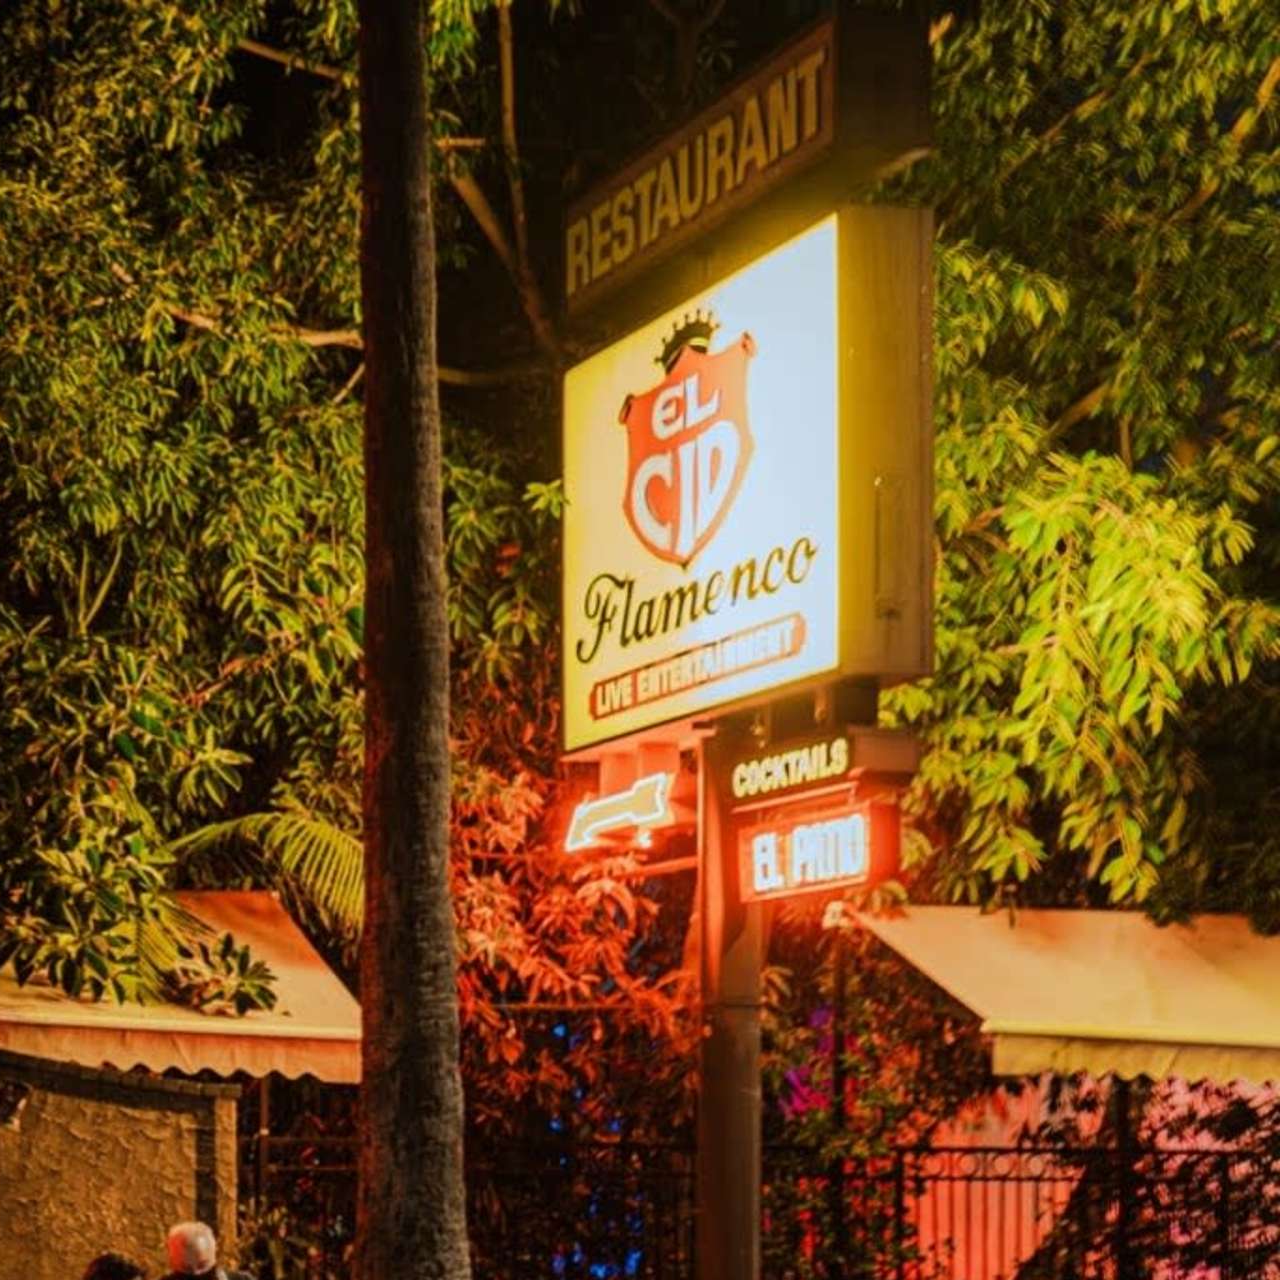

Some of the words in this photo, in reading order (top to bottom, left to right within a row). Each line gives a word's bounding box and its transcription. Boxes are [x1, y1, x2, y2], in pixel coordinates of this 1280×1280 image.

[567, 48, 827, 296] RESTAURANT
[651, 373, 721, 440] EL
[631, 420, 739, 558] CID
[576, 536, 818, 664] Flamenco
[732, 738, 848, 798] COCKTAILS
[754, 833, 784, 892] EL
